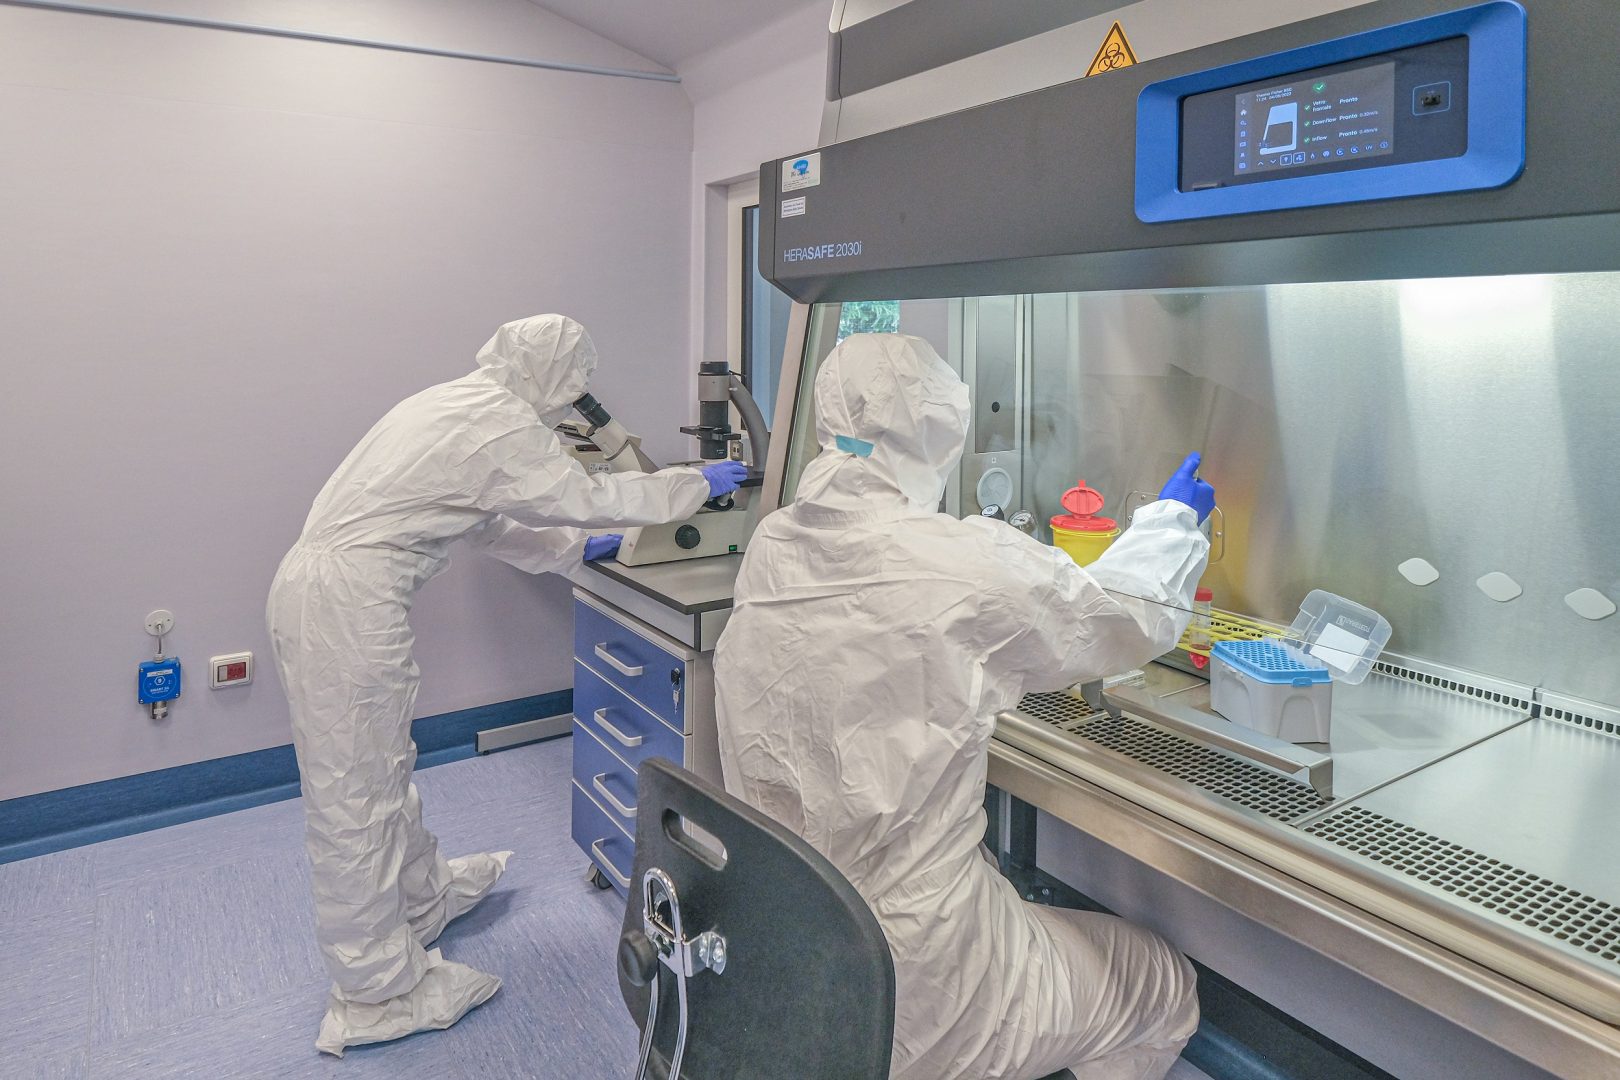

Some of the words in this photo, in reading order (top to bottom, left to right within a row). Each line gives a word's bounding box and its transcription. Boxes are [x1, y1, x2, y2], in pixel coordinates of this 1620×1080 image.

[1339, 96, 1358, 104] Pronto
[1312, 117, 1337, 126] Downflow
[783, 243, 835, 262] HERASAFE
[836, 240, 862, 257] 2030i
